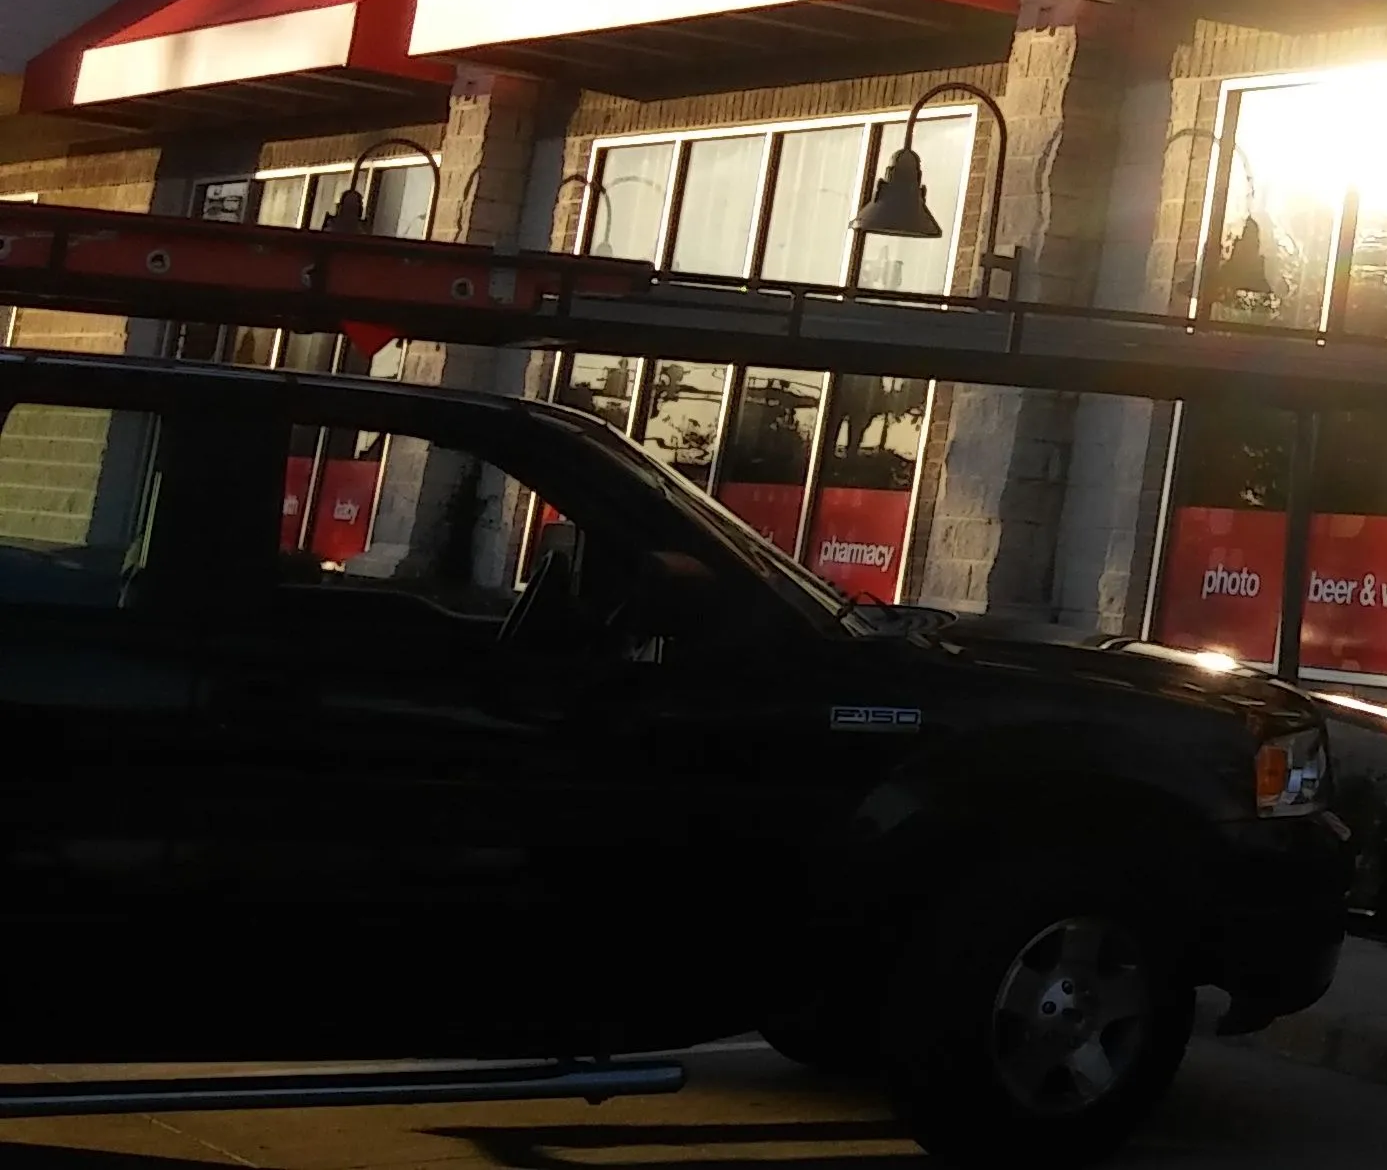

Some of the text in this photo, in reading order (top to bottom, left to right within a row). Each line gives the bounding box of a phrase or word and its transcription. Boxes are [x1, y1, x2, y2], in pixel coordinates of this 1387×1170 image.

[819, 534, 895, 573] pharmacy
[1202, 563, 1261, 599] photo
[1307, 570, 1356, 606] beer
[1359, 572, 1376, 607] &
